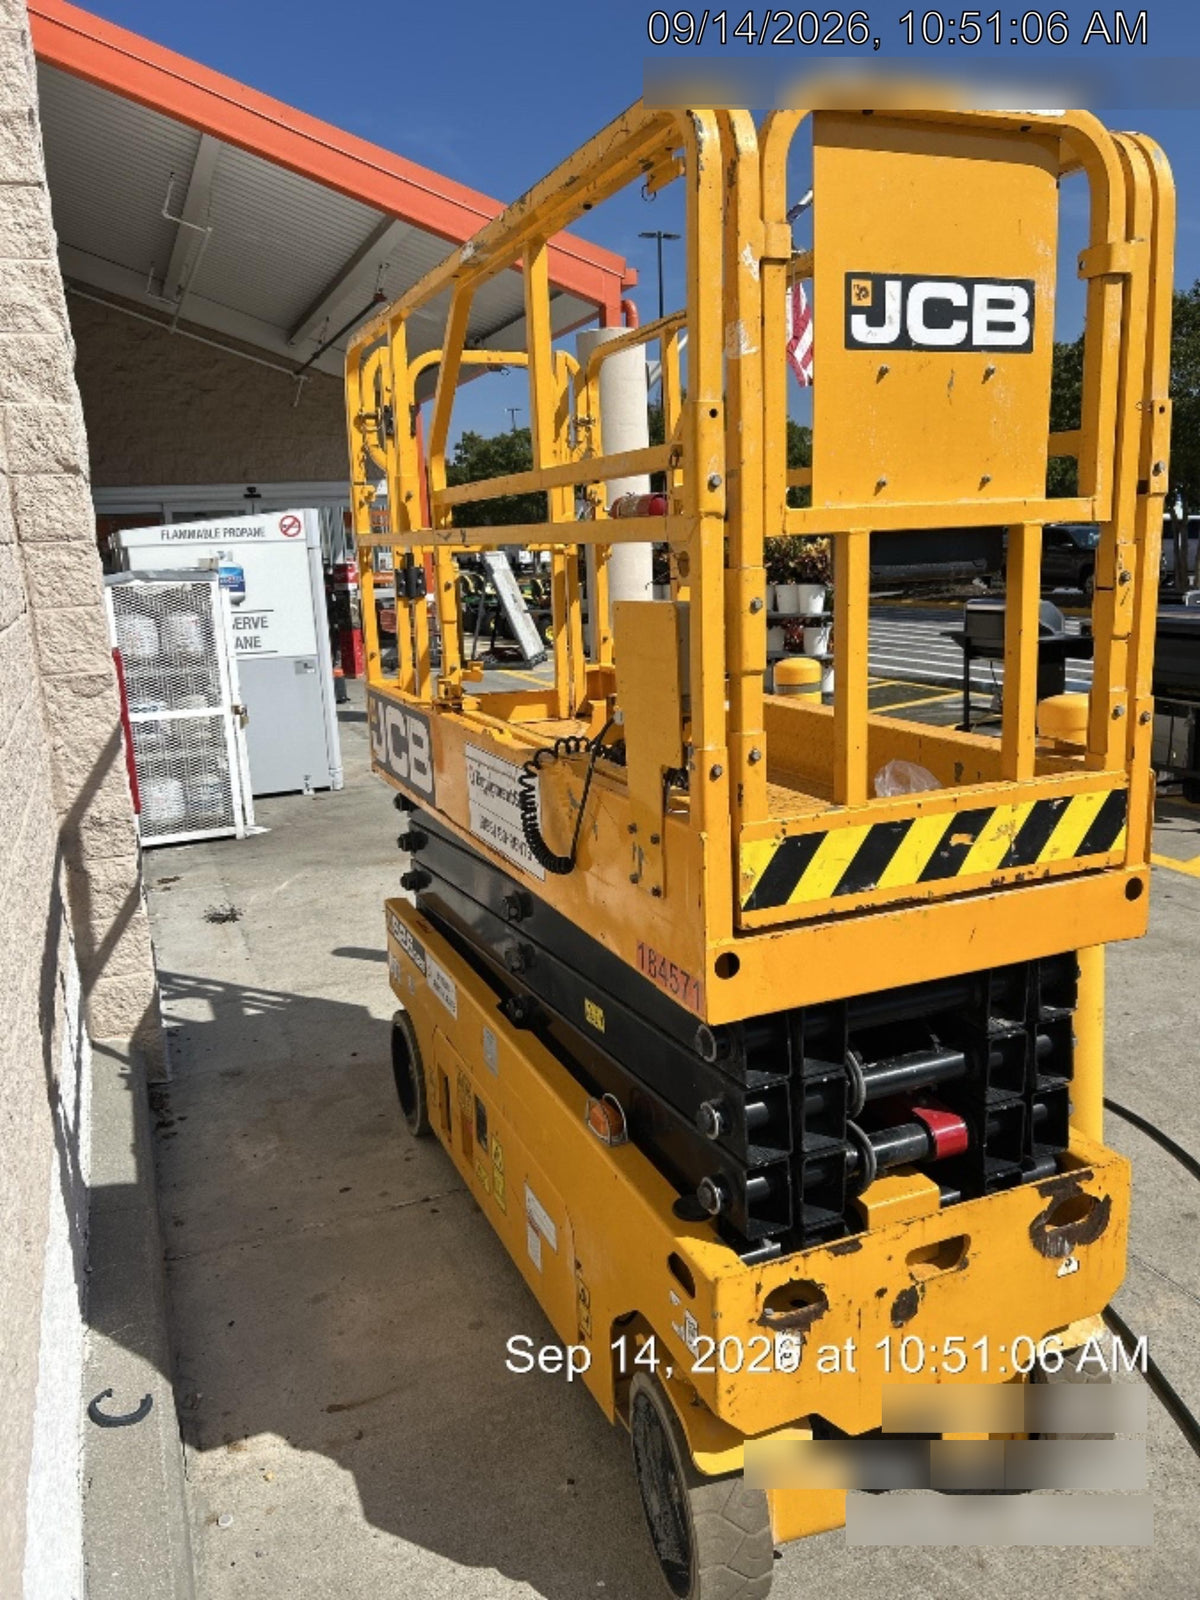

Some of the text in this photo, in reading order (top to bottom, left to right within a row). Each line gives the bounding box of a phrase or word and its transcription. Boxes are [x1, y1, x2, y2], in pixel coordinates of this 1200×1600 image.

[851, 280, 1030, 345] JCB
[161, 527, 266, 540] FLAMMABLE PROPANE
[371, 701, 433, 793] JCB
